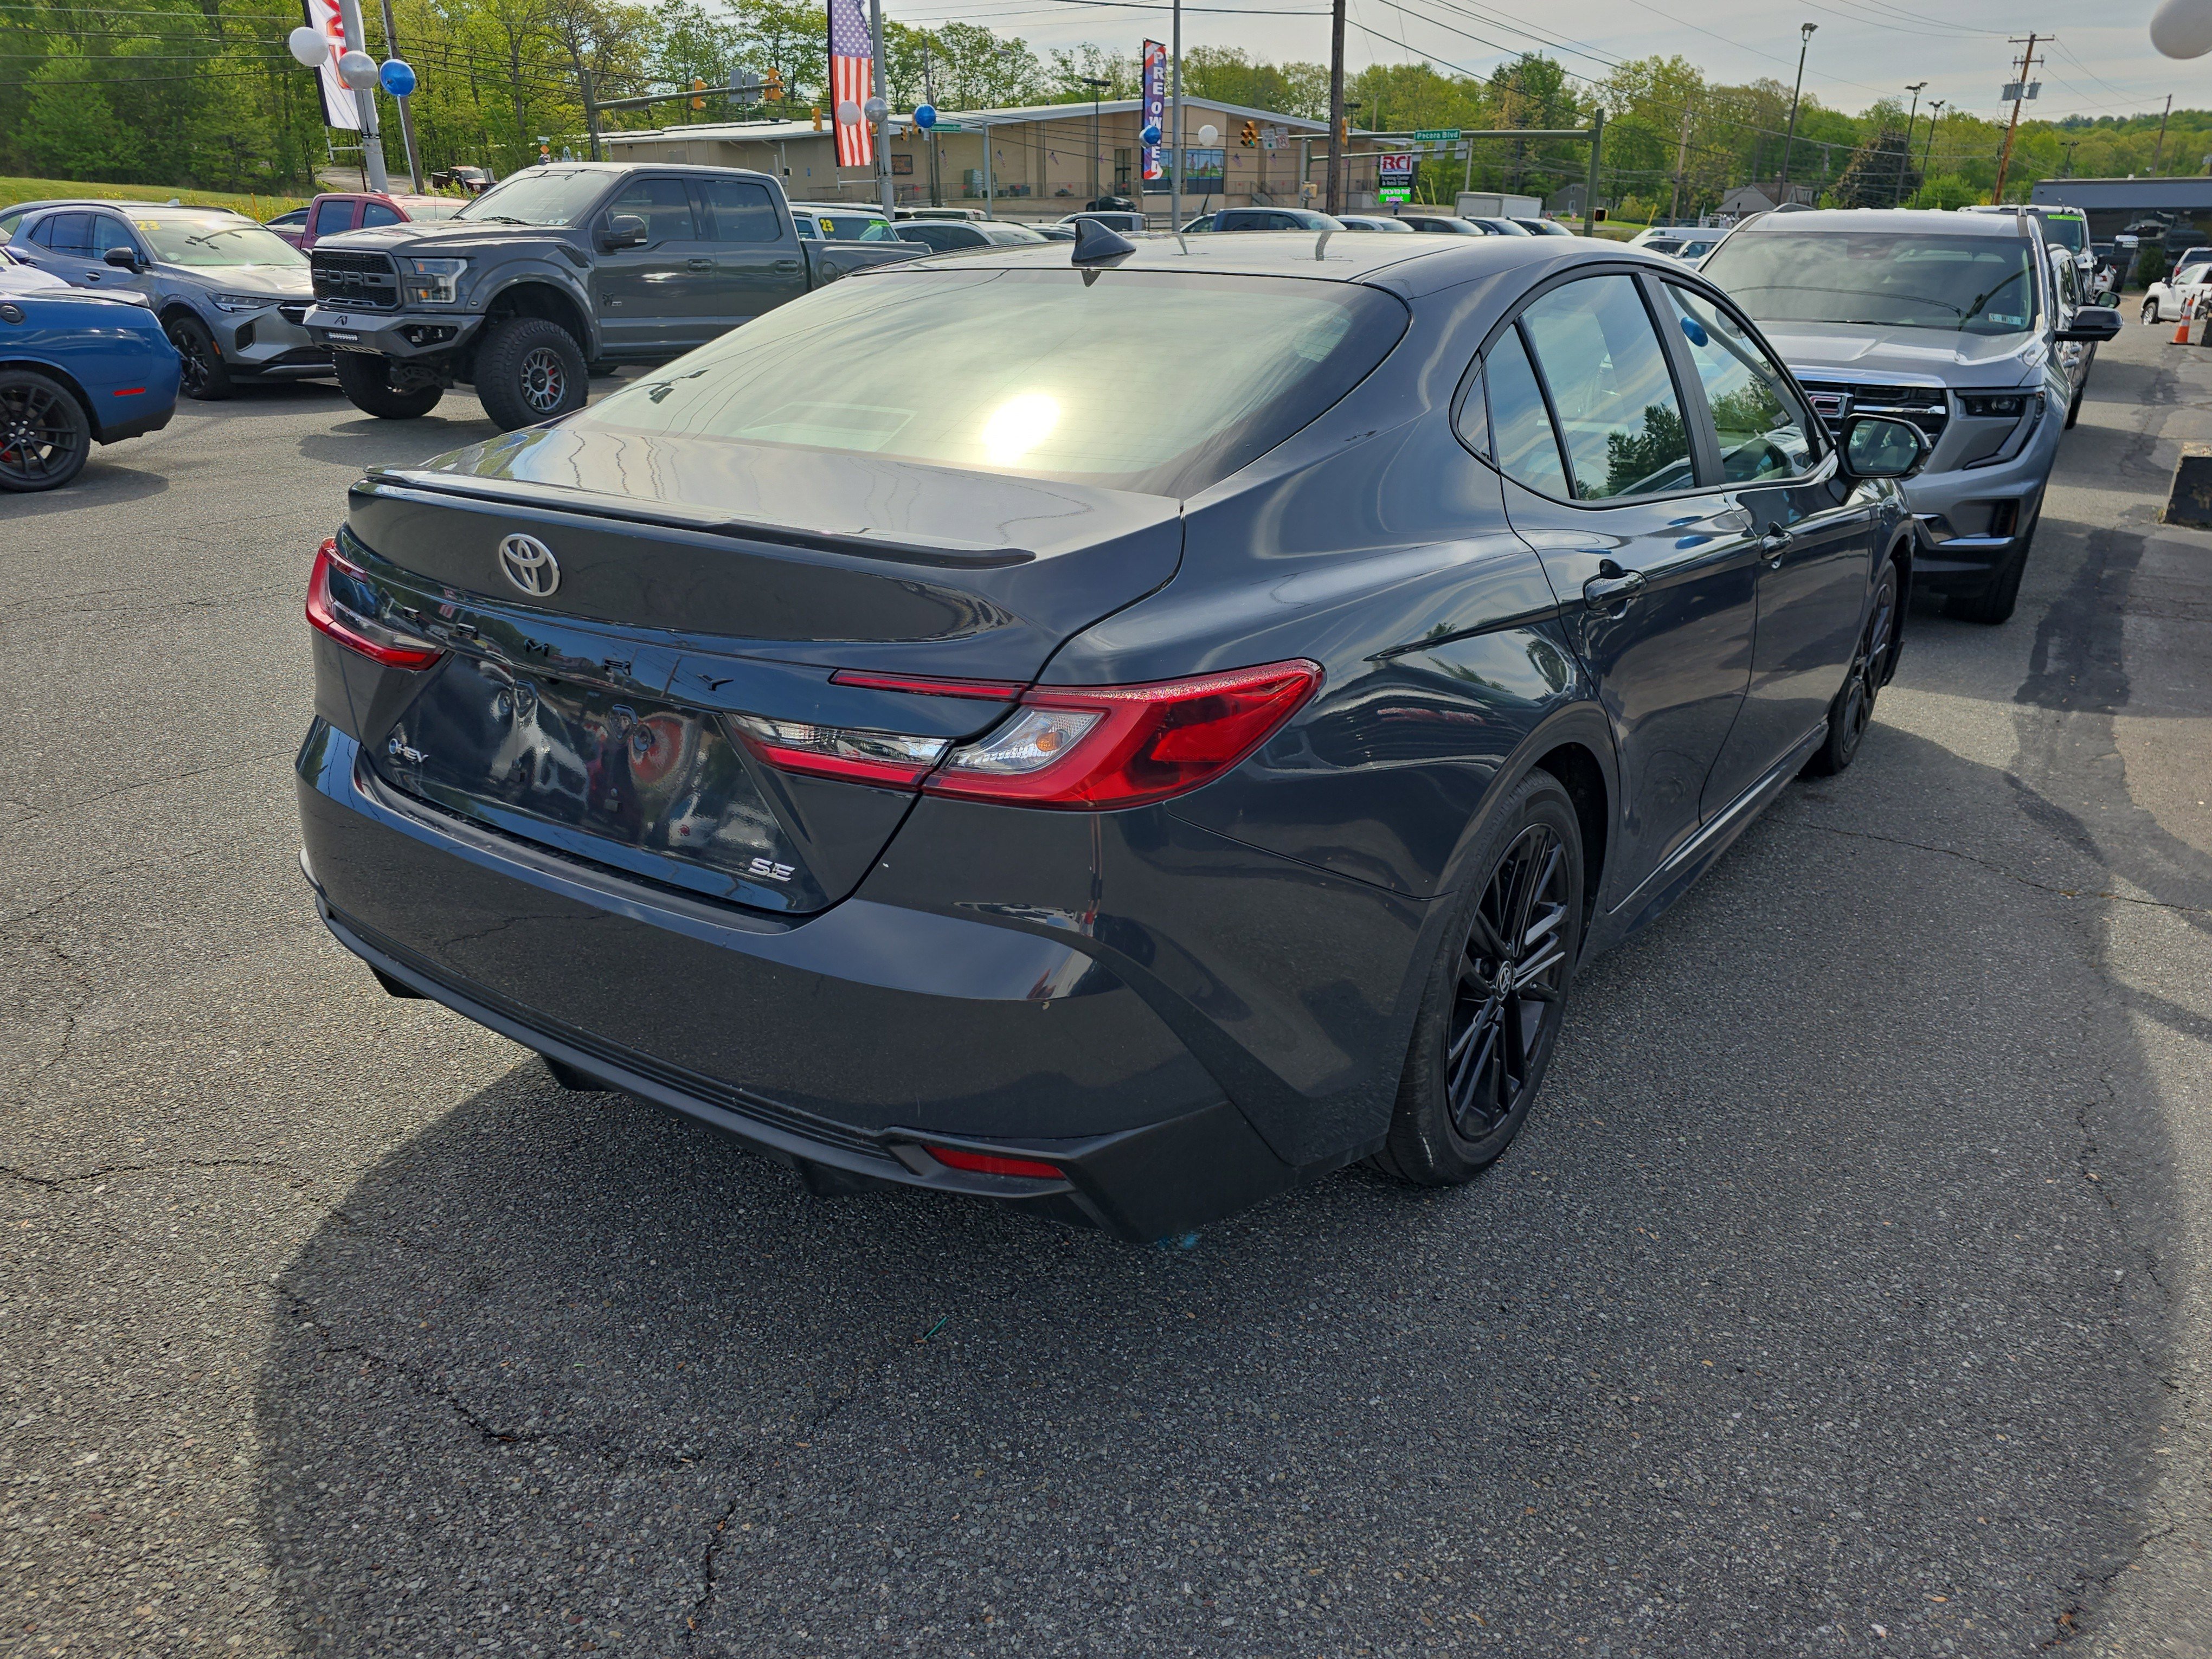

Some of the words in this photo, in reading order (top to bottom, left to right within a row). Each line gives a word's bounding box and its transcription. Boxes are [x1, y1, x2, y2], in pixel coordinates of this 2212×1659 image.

[1149, 101, 1162, 172] OWED
[136, 220, 162, 231] 23
[820, 218, 834, 232] 23
[313, 269, 384, 287] FORD
[402, 606, 735, 692] CAMRY
[748, 858, 795, 882] SE
